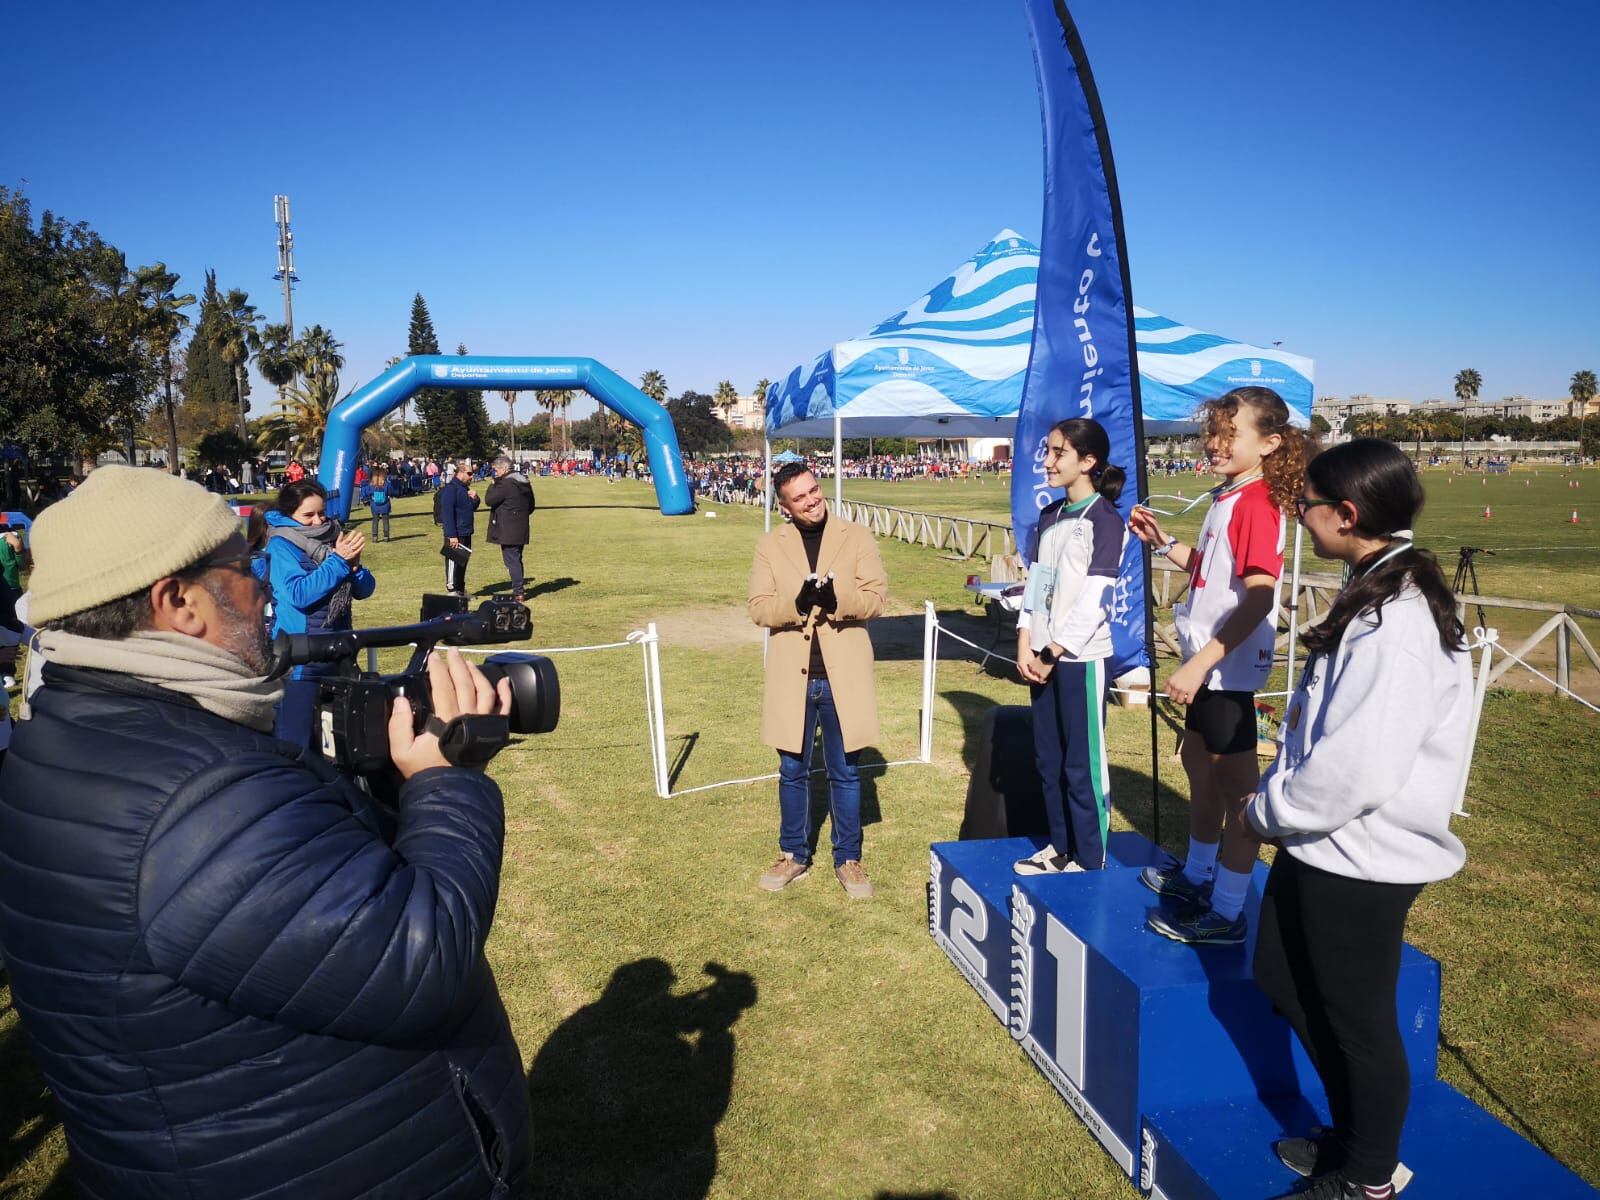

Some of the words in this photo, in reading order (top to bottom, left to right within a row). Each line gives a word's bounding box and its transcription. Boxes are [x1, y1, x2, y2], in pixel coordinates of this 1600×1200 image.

[451, 366, 527, 374] Ayuntamiento
[531, 366, 542, 374] de
[950, 877, 989, 978] 2
[1046, 912, 1087, 1091] 1
[1031, 1043, 1073, 1100] Ayuntamiento
[1073, 1095, 1083, 1112] de
[1083, 1105, 1101, 1134] Jerez
